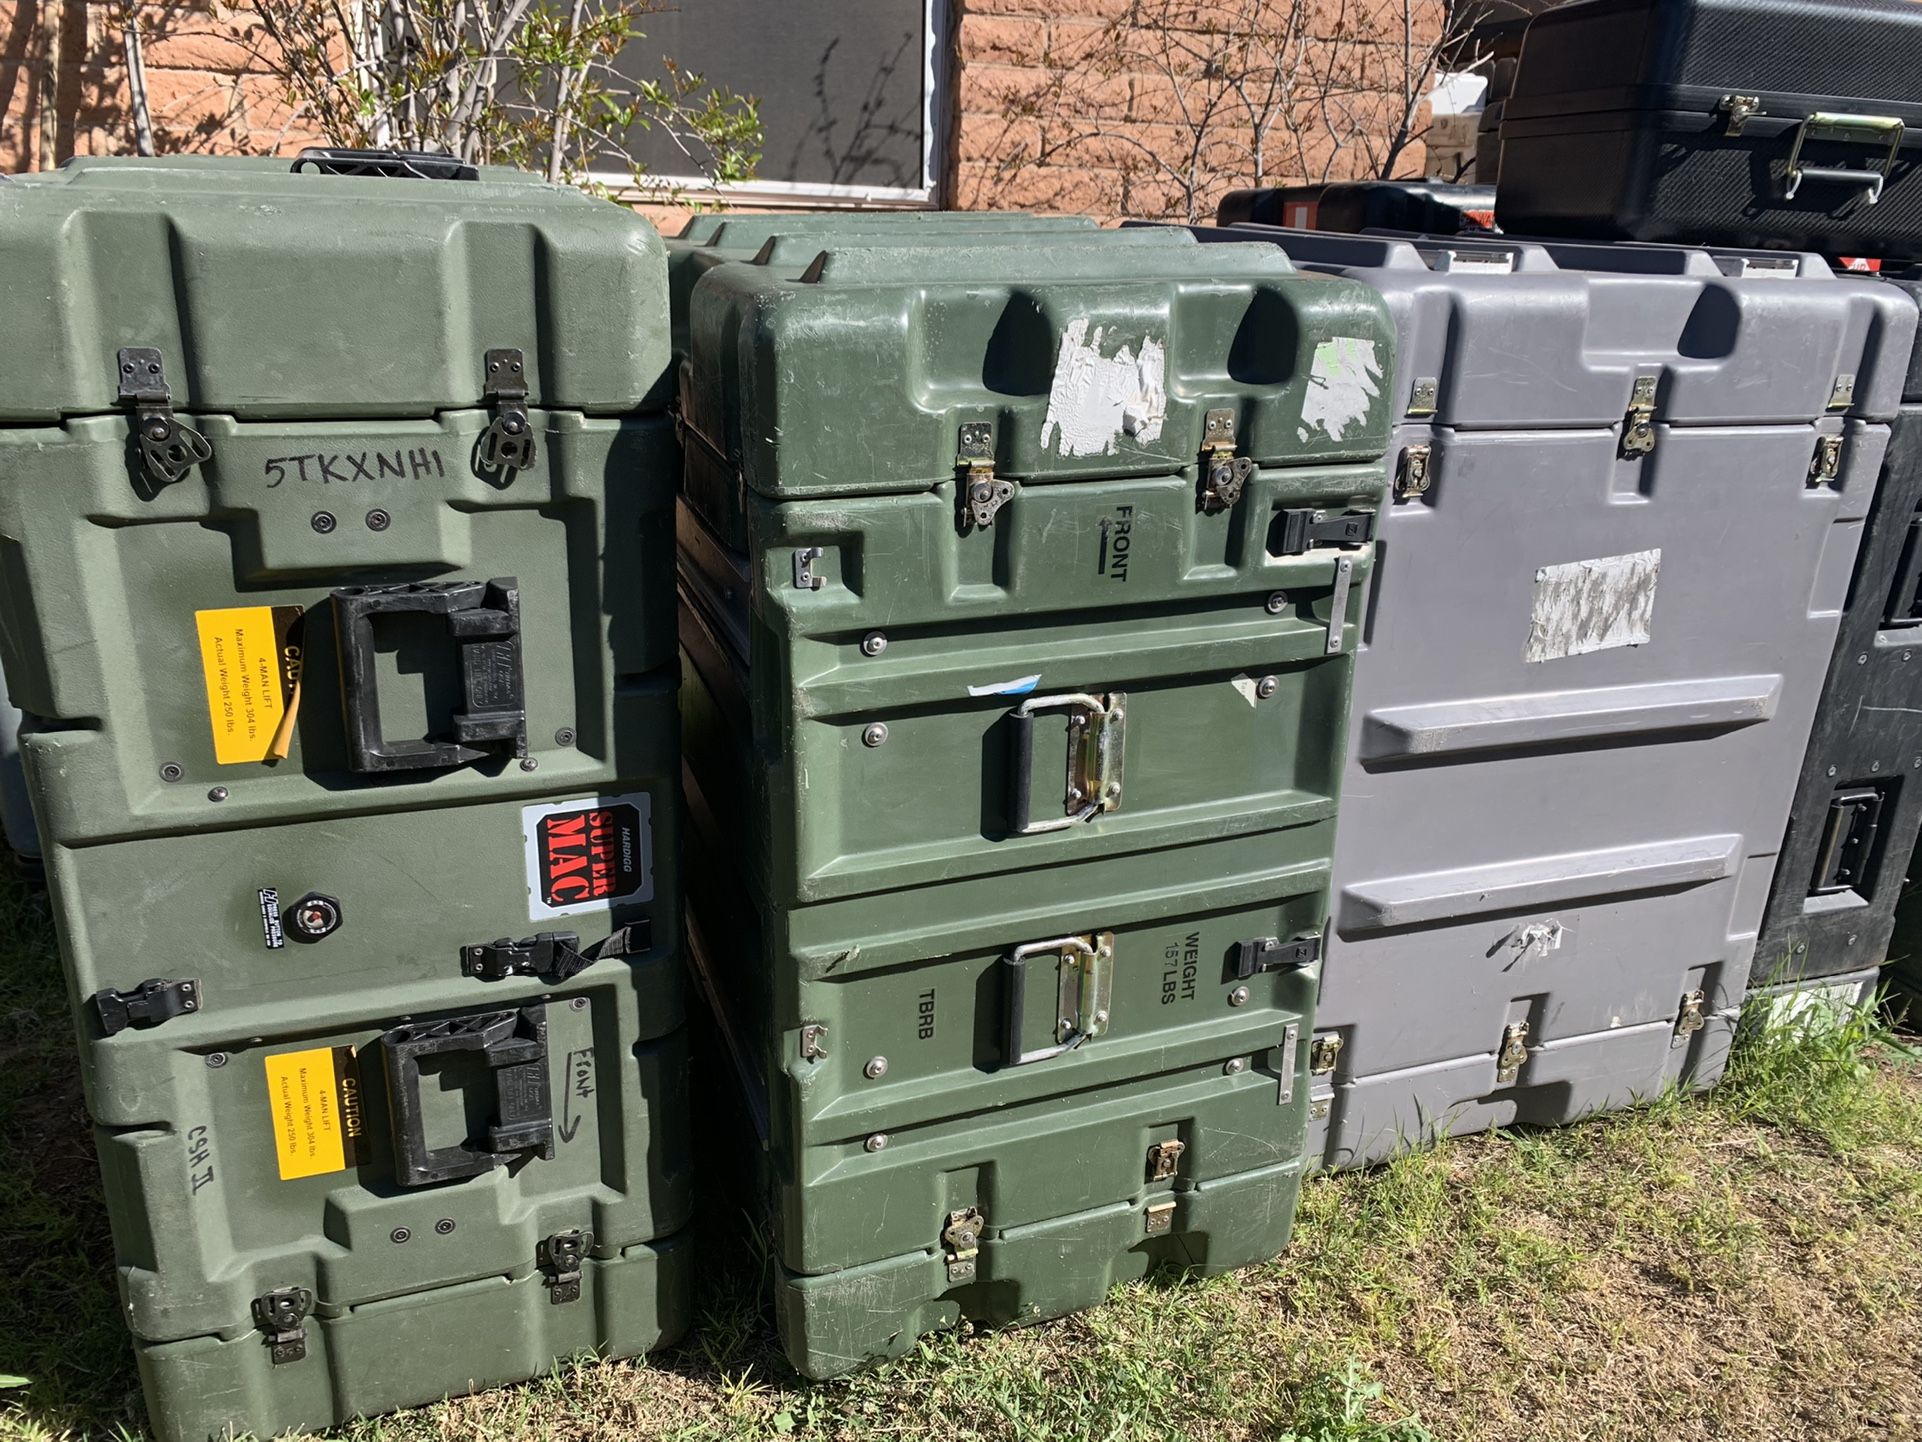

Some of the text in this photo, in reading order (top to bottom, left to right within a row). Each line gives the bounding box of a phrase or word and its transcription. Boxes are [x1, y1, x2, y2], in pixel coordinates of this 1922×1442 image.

[1111, 506, 1133, 582] FRONT
[214, 637, 235, 735] Actual Weight 250 lbs.
[235, 629, 257, 741] Maximum Weight 304 lbs.
[259, 658, 272, 708] 4-MAN LIFT
[547, 815, 589, 902] MAC
[590, 810, 616, 897] SUPER
[622, 827, 632, 872] HARDIGG
[1162, 942, 1180, 1005] 157 LBS
[1181, 932, 1199, 1000] WEIGHT
[919, 989, 934, 1039] TBRB
[280, 1076, 290, 1099] Actual
[284, 1101, 293, 1126] Weight
[299, 1068, 309, 1103] Maximum
[304, 1105, 313, 1130] Weight
[320, 1090, 331, 1130] 4-MAN LIFT
[342, 1078, 362, 1137] CAUTION
[188, 1126, 210, 1168] CSH
[288, 1128, 296, 1141] 250
